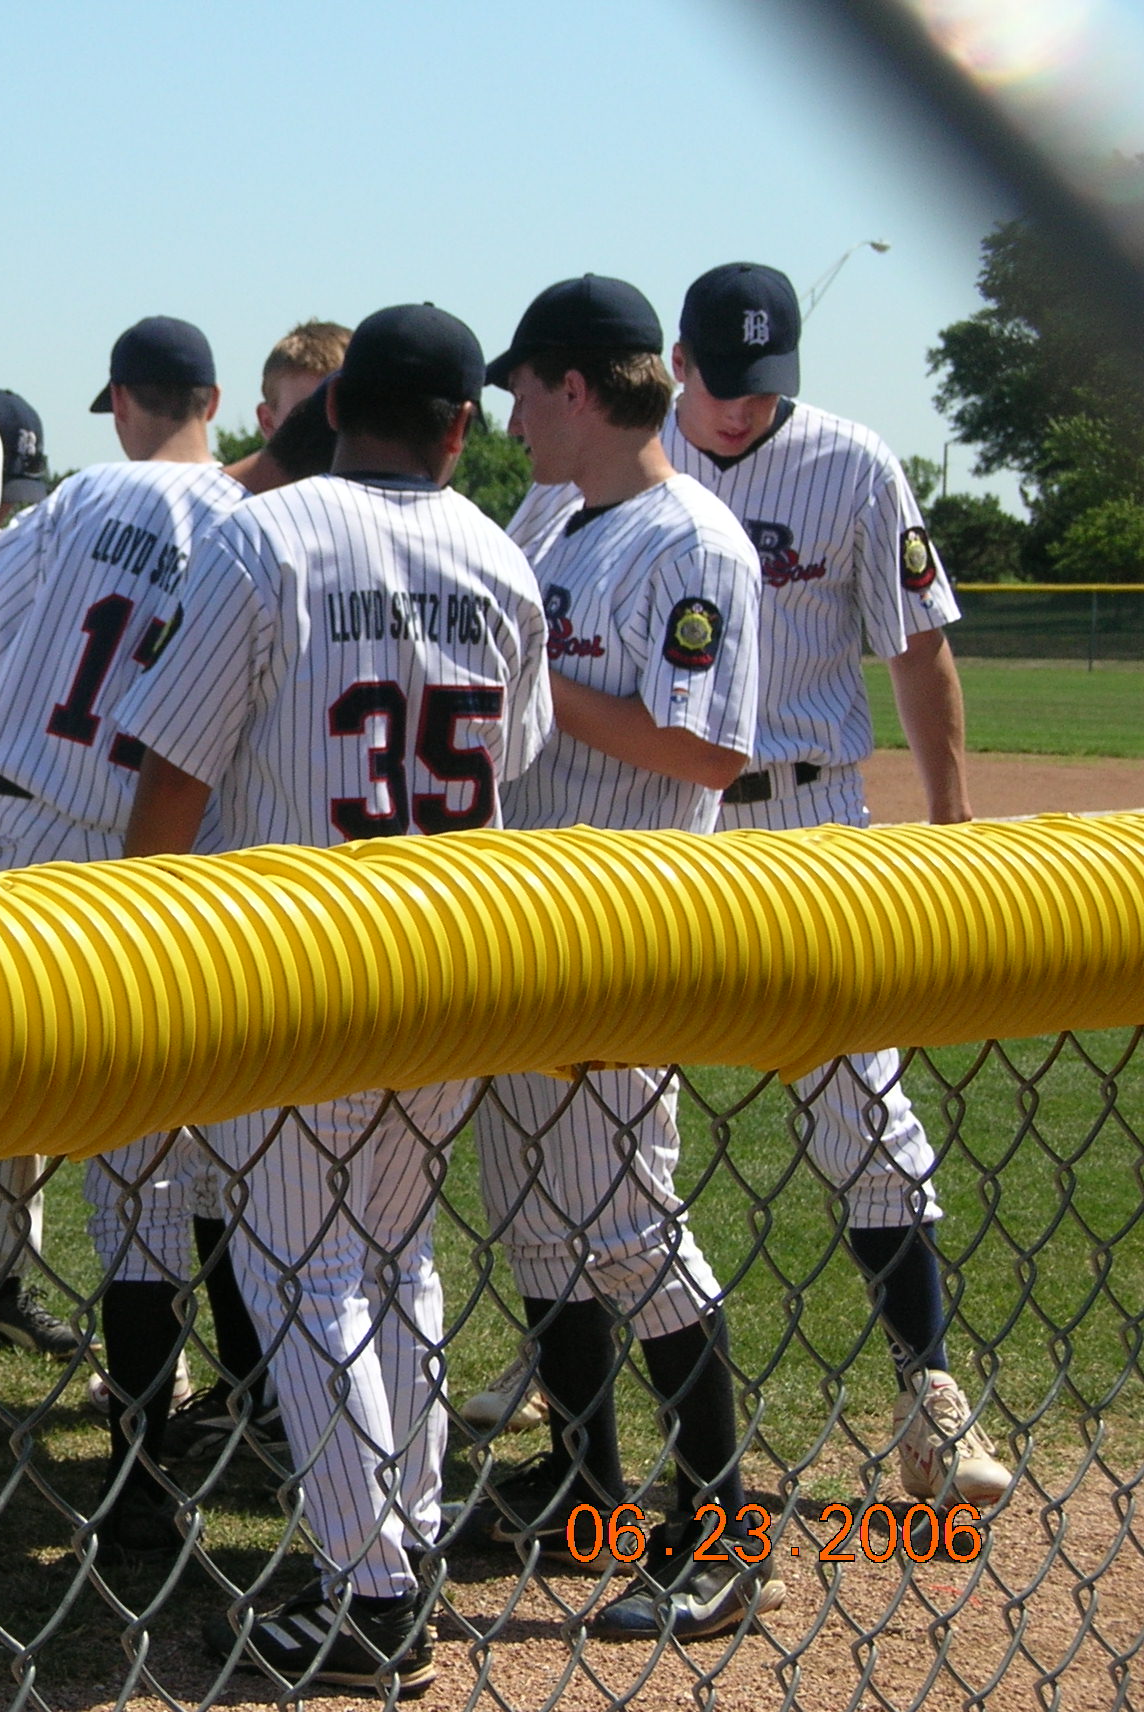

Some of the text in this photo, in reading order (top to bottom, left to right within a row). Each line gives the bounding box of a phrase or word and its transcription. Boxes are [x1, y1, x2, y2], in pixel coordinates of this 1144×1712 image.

[742, 309, 770, 346] B
[91, 517, 157, 577] LLOYD
[328, 589, 385, 643] LLOYD
[328, 679, 505, 841] 35
